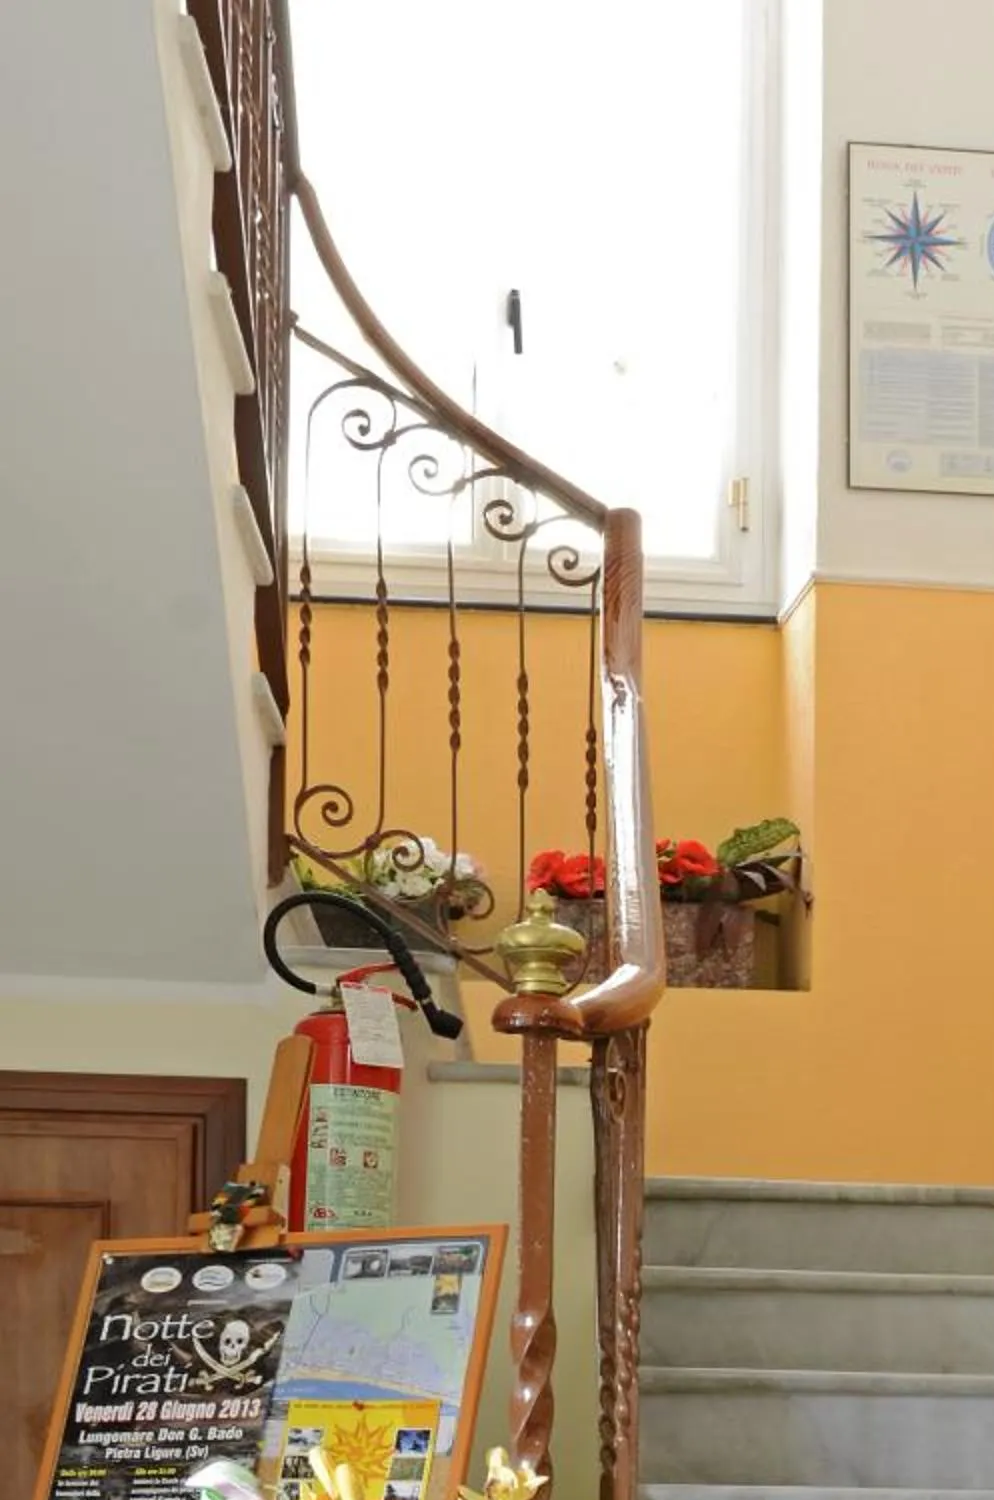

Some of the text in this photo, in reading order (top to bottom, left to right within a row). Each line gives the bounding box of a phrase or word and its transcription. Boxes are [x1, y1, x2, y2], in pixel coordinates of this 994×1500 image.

[131, 1343, 171, 1367] dei
[83, 1363, 190, 1395] Pirati
[135, 1400, 159, 1421] 28
[160, 1399, 217, 1421] Giugno
[218, 1397, 262, 1419] 2013
[79, 1425, 244, 1446] Lungomare Don G. Bado
[104, 1445, 141, 1460] Pietra
[143, 1445, 183, 1460] Ligure
